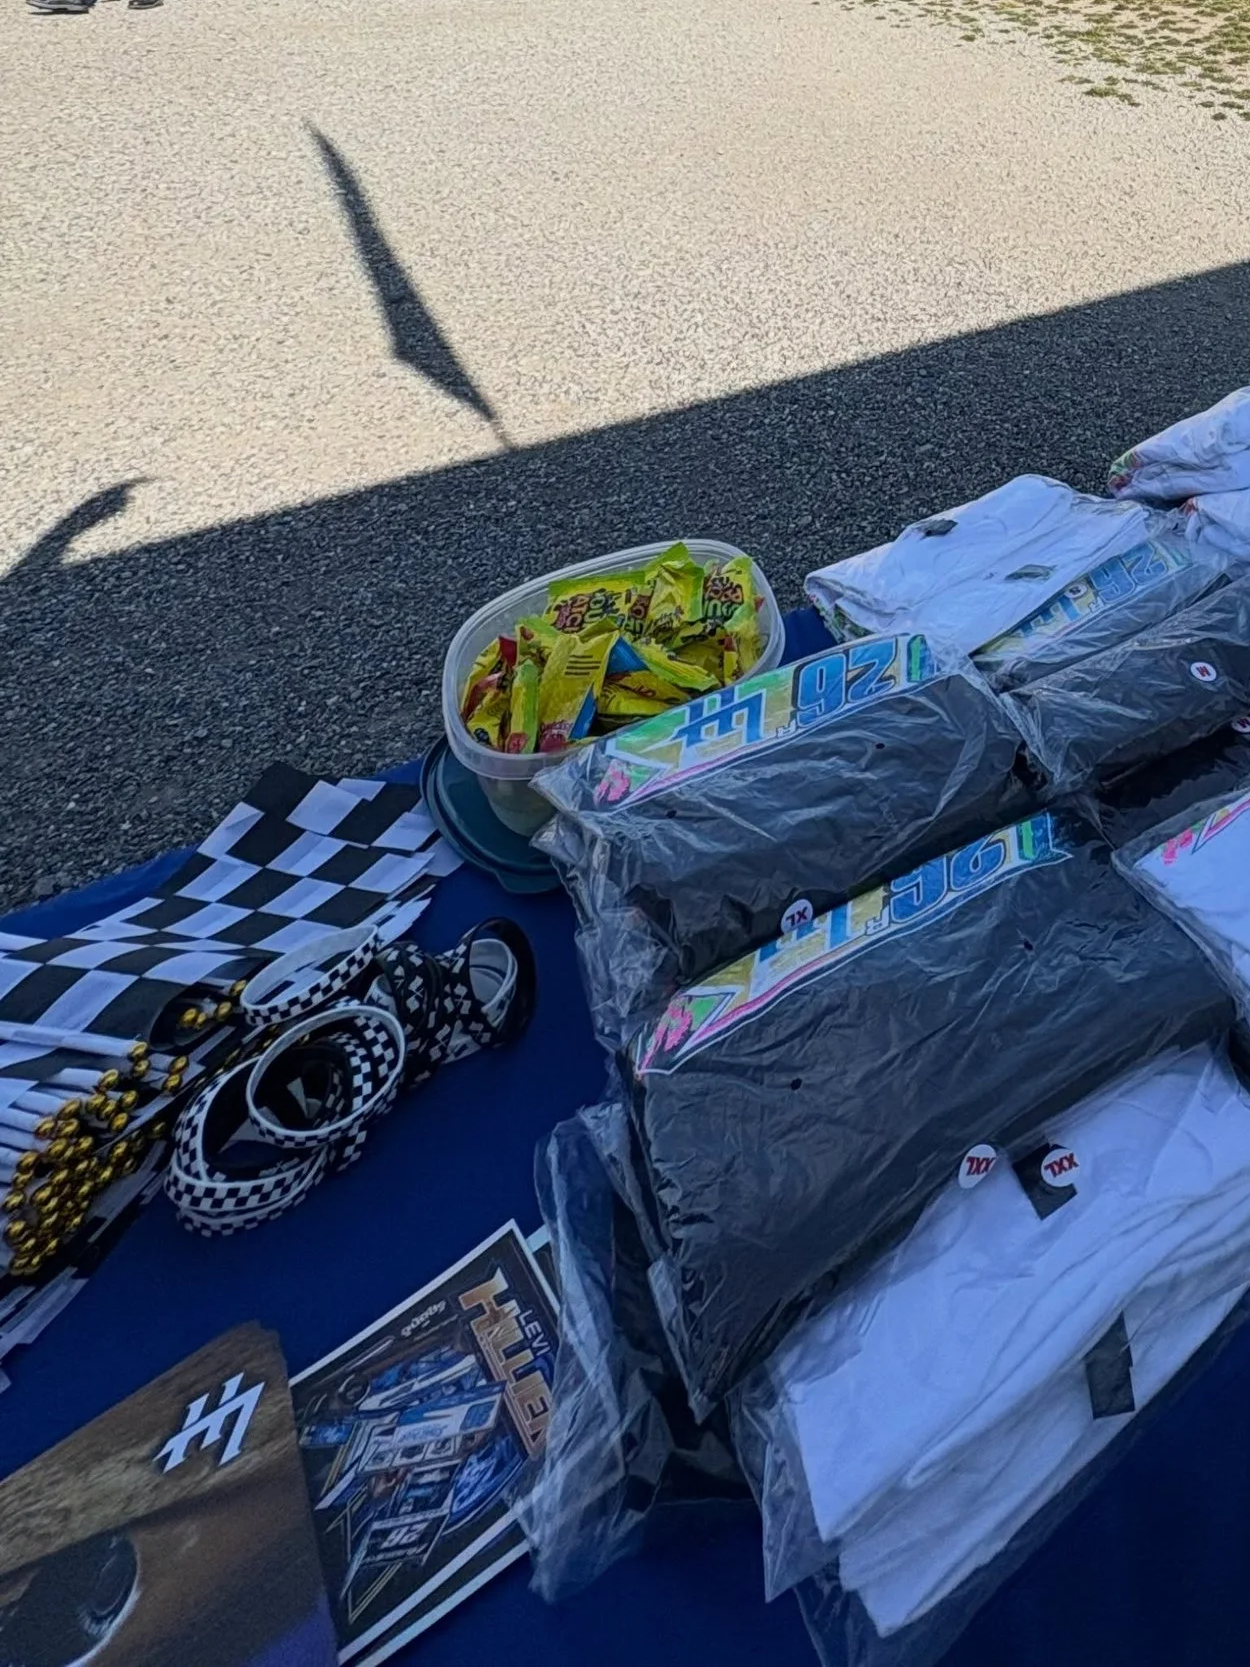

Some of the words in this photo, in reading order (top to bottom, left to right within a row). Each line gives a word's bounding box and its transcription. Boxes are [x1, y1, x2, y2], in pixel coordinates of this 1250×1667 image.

[785, 906, 809, 927] XL
[965, 1156, 997, 1177] XXL
[1044, 1152, 1080, 1179] XXL
[518, 1309, 551, 1356] LEVI
